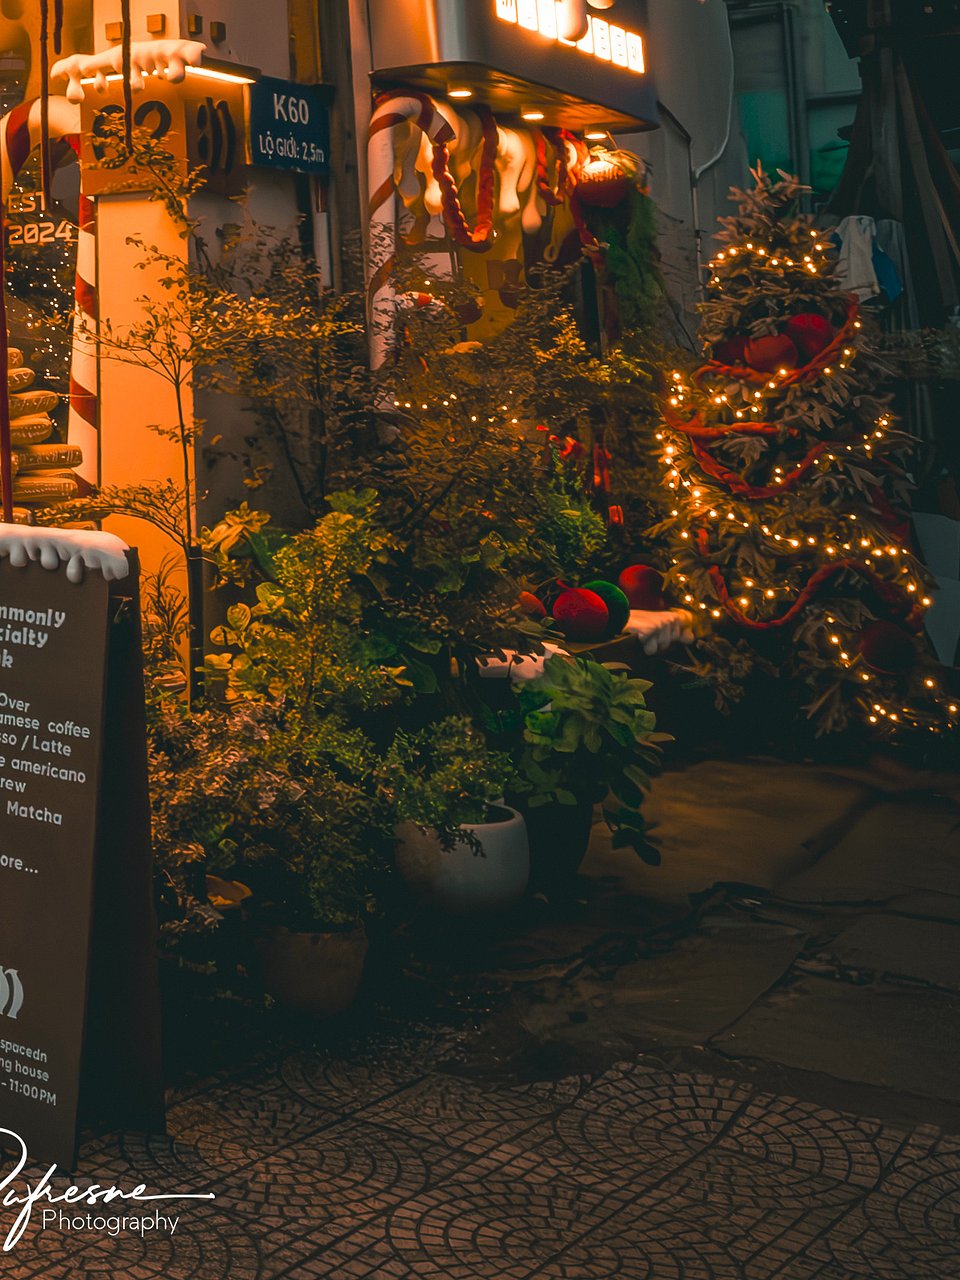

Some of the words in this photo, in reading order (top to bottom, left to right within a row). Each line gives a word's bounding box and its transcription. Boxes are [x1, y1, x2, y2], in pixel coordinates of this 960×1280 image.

[273, 93, 309, 125] K60
[8, 220, 72, 245] 2024
[48, 720, 90, 738] coffee
[33, 739, 72, 756] Latte
[11, 758, 86, 783] americano
[7, 801, 63, 825] Matcha
[15, 1060, 50, 1082] house
